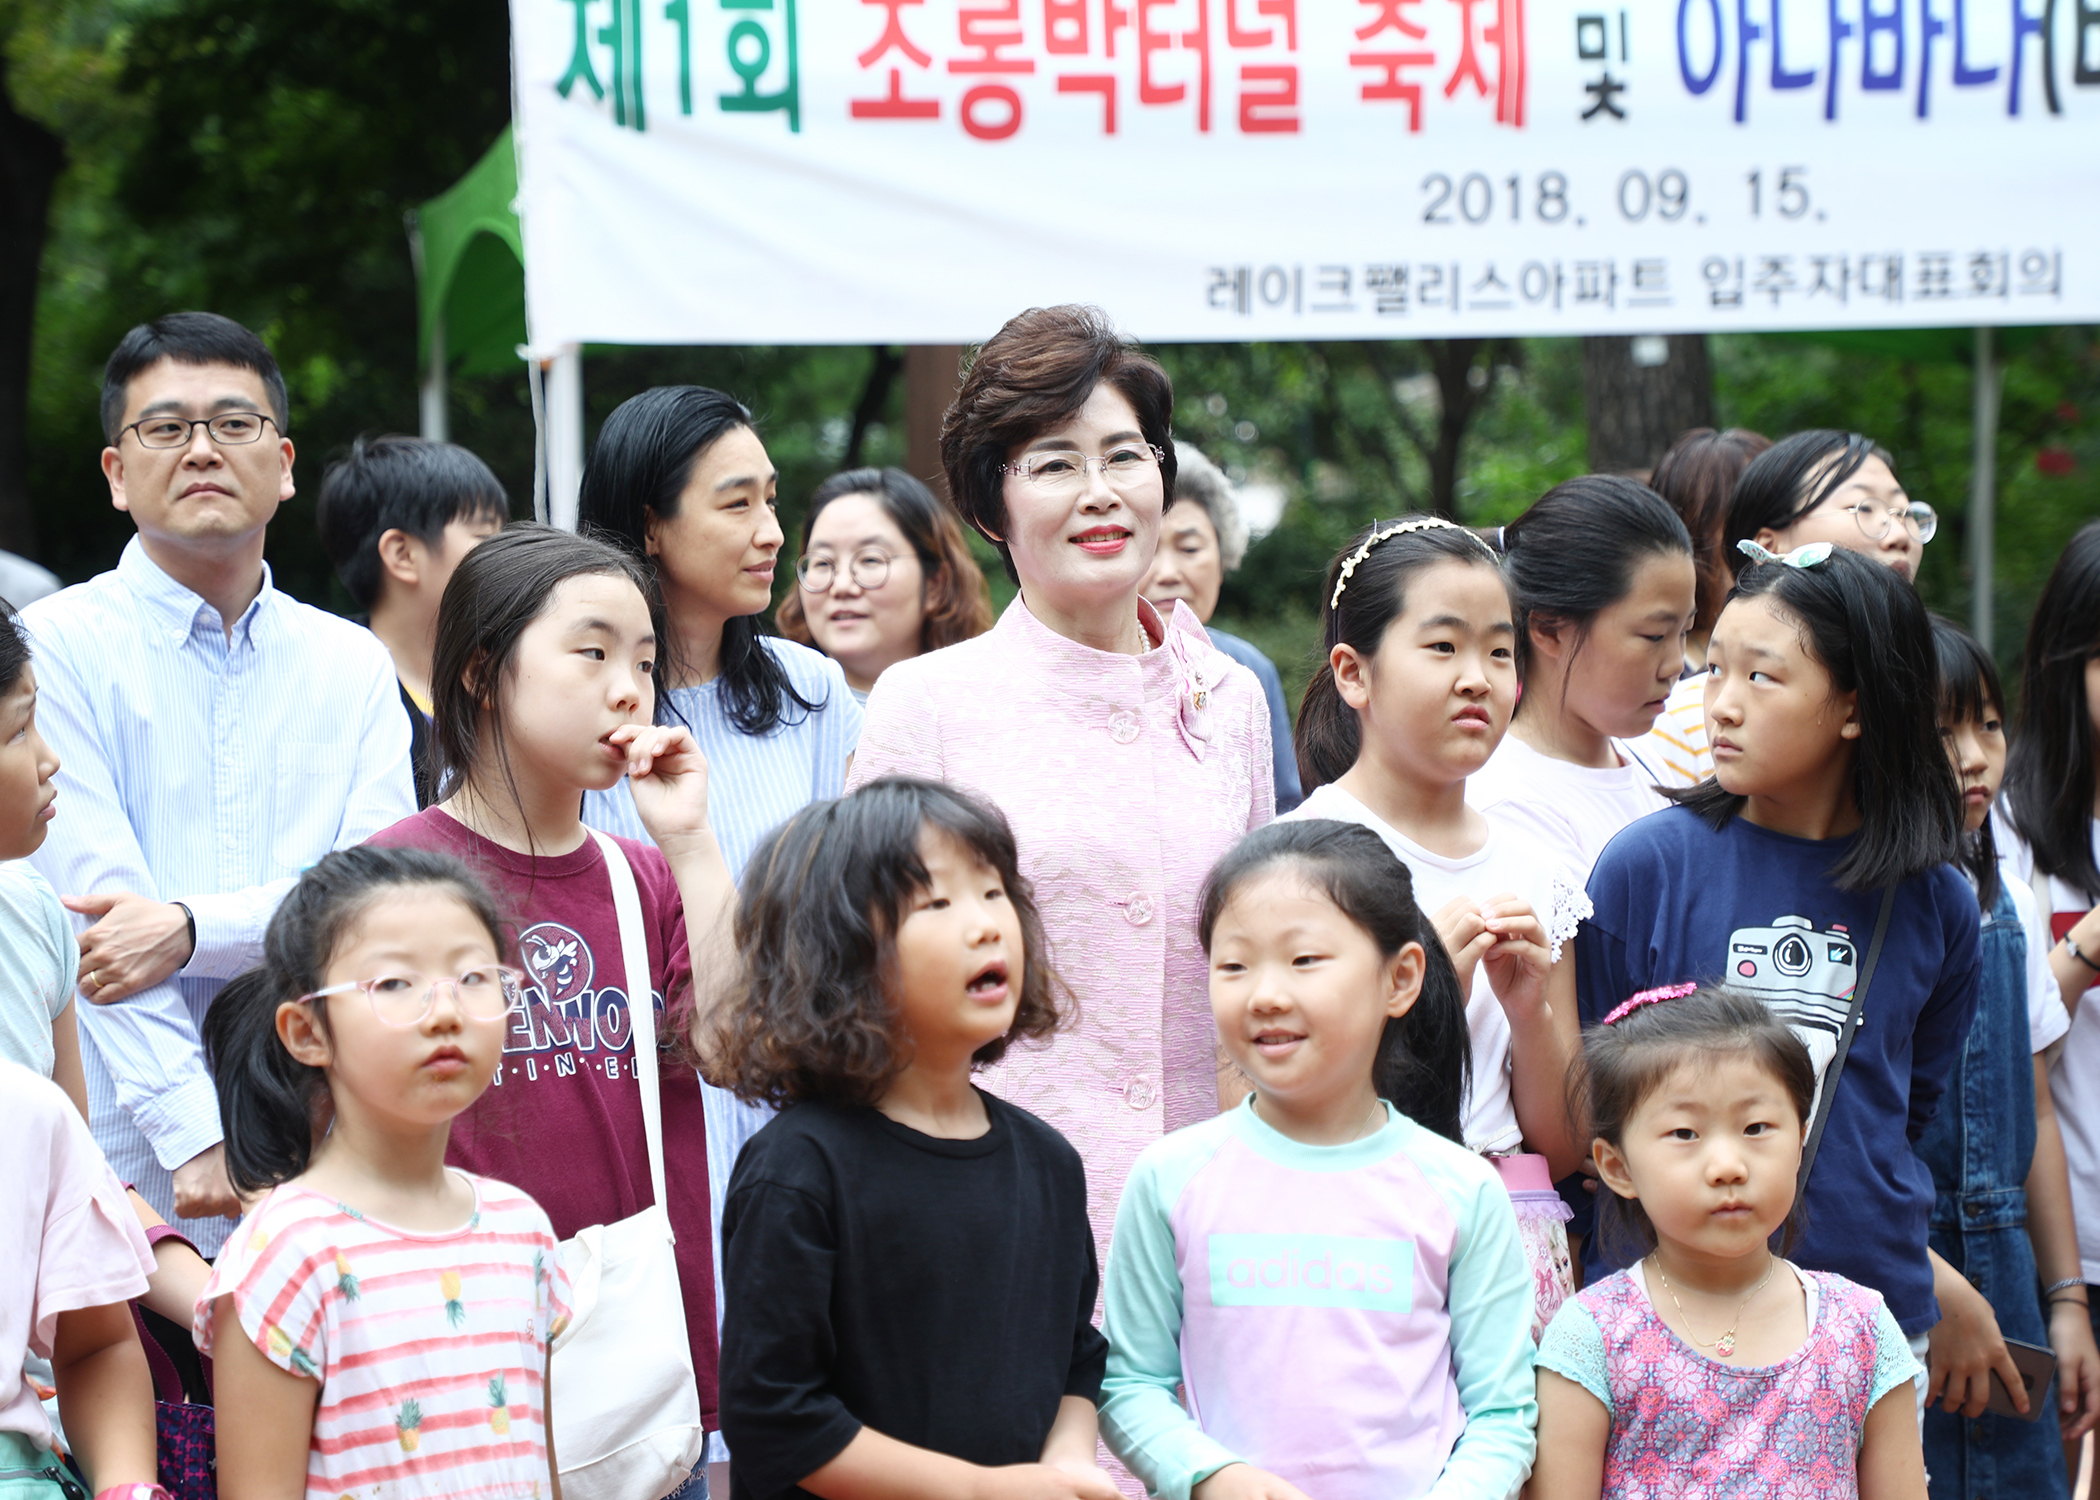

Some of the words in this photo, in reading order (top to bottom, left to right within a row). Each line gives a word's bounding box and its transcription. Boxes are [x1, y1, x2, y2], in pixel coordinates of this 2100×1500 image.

[554, 0, 802, 134] 제1회
[1349, 0, 1526, 132] 축제
[1576, 11, 1629, 121] 및
[1421, 171, 1586, 227] 2018.
[1617, 168, 1707, 226] 09.
[1745, 166, 1828, 223] 15.
[1701, 250, 2063, 309] 입주자대표회의
[1226, 1248, 1395, 1294] adidas
